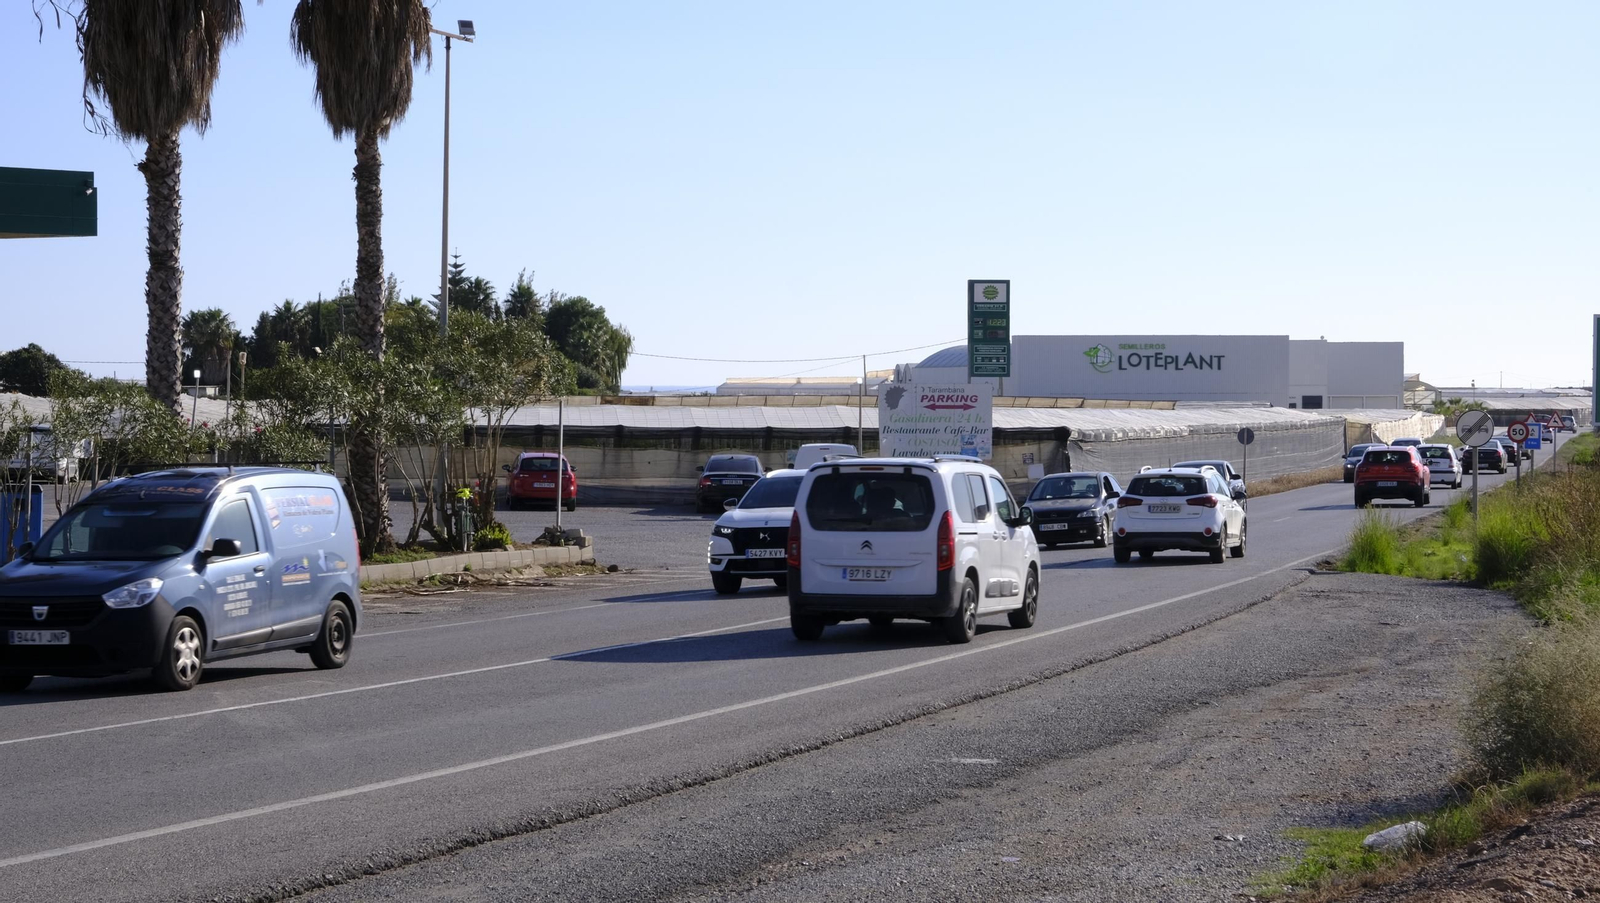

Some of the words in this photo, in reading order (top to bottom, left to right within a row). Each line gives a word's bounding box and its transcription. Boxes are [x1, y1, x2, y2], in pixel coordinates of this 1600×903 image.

[1118, 351, 1225, 371] LOTEPLANT
[927, 386, 965, 394] Tarambana
[920, 394, 978, 403] PARKING
[889, 413, 952, 423] Gasolinera
[957, 413, 971, 423] 24
[882, 425, 941, 435] Restaurante
[944, 425, 989, 436] Café-Bar
[1511, 427, 1525, 436] 50
[892, 448, 929, 457] Lavado
[769, 549, 783, 557] KVY
[848, 569, 871, 579] 9716
[874, 569, 892, 579] LZY
[16, 631, 42, 643] 9441
[46, 631, 67, 643] JNP
